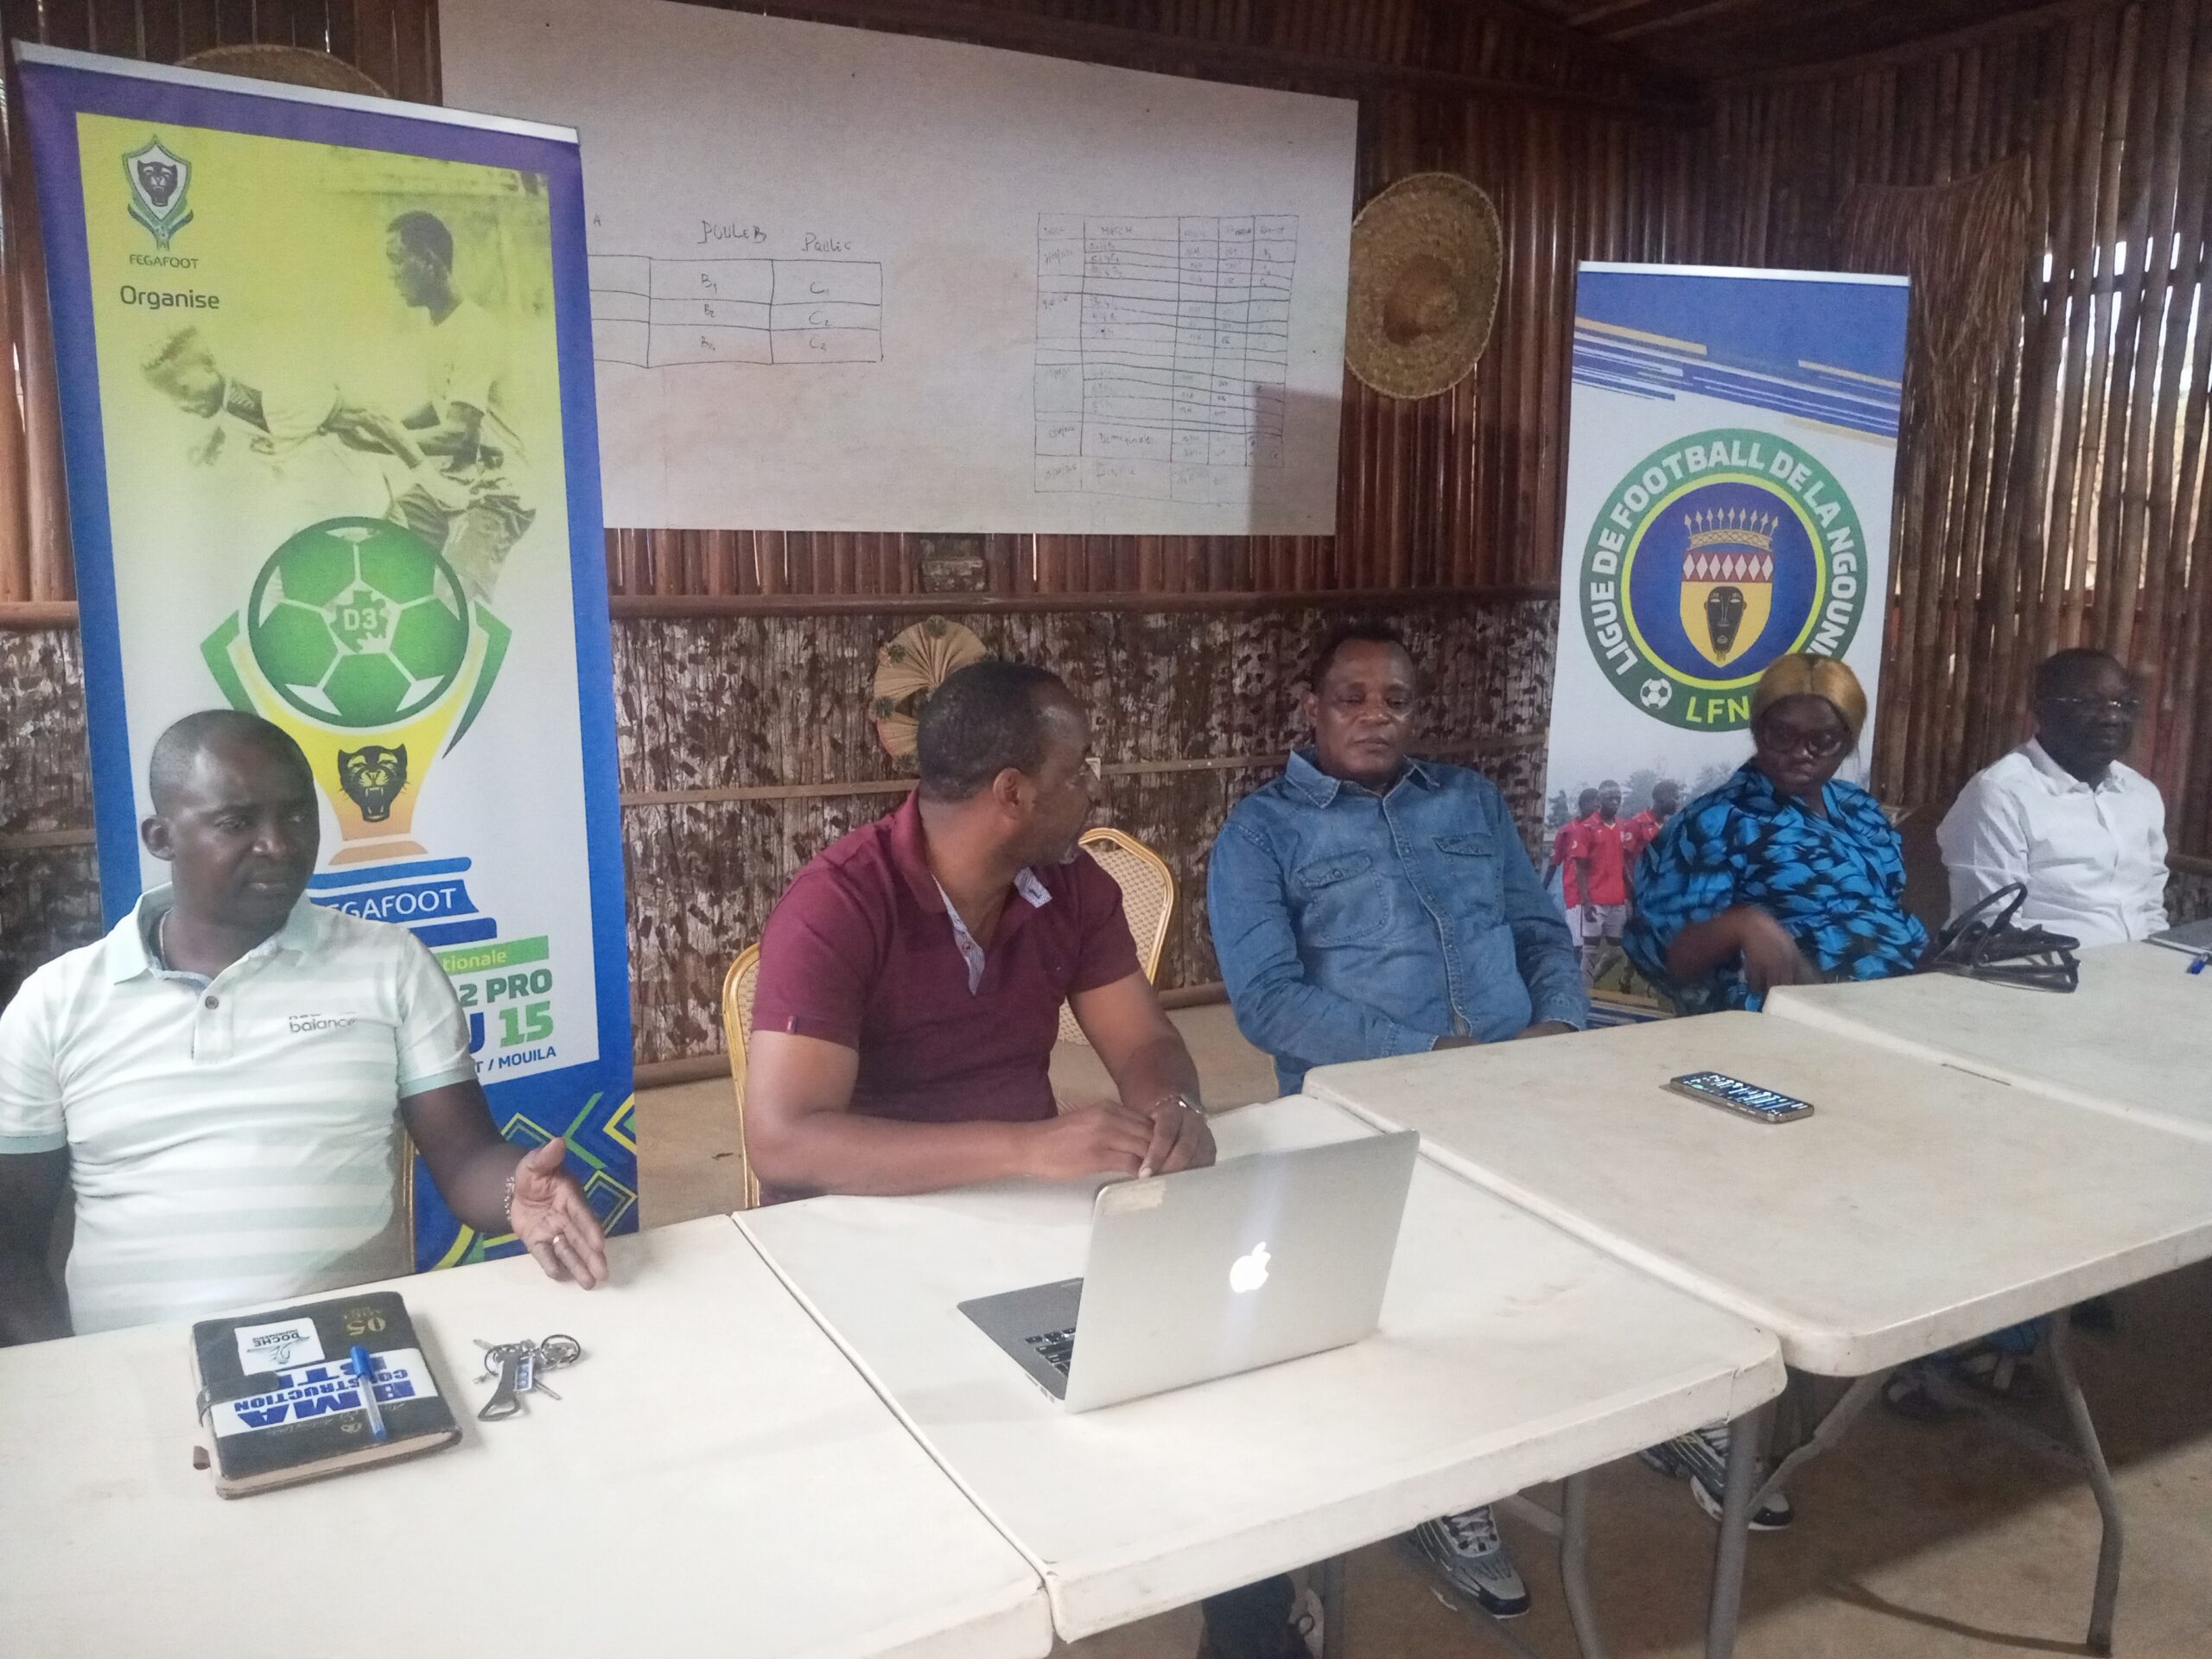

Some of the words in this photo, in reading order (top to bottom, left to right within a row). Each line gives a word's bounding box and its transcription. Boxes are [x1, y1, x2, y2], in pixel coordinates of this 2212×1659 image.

[753, 226, 767, 244] B
[130, 254, 200, 270] FEGAFOOT
[119, 284, 220, 310] Organise
[1609, 439, 1765, 531] FOOTBALL
[1768, 449, 1813, 491] DE
[1801, 480, 1842, 530] LA
[1592, 527, 1625, 576] DE
[1805, 525, 1858, 658] NGOUNI
[343, 607, 378, 632] D3
[1590, 582, 1638, 677] LIGUE
[1686, 695, 1751, 724] LFN
[326, 887, 457, 920] GAFOOT
[442, 948, 508, 972] tionale
[486, 968, 553, 1003] PRO
[499, 1000, 554, 1049] 15
[498, 1046, 557, 1070] MOUILA
[254, 1332, 300, 1347] DOCHE
